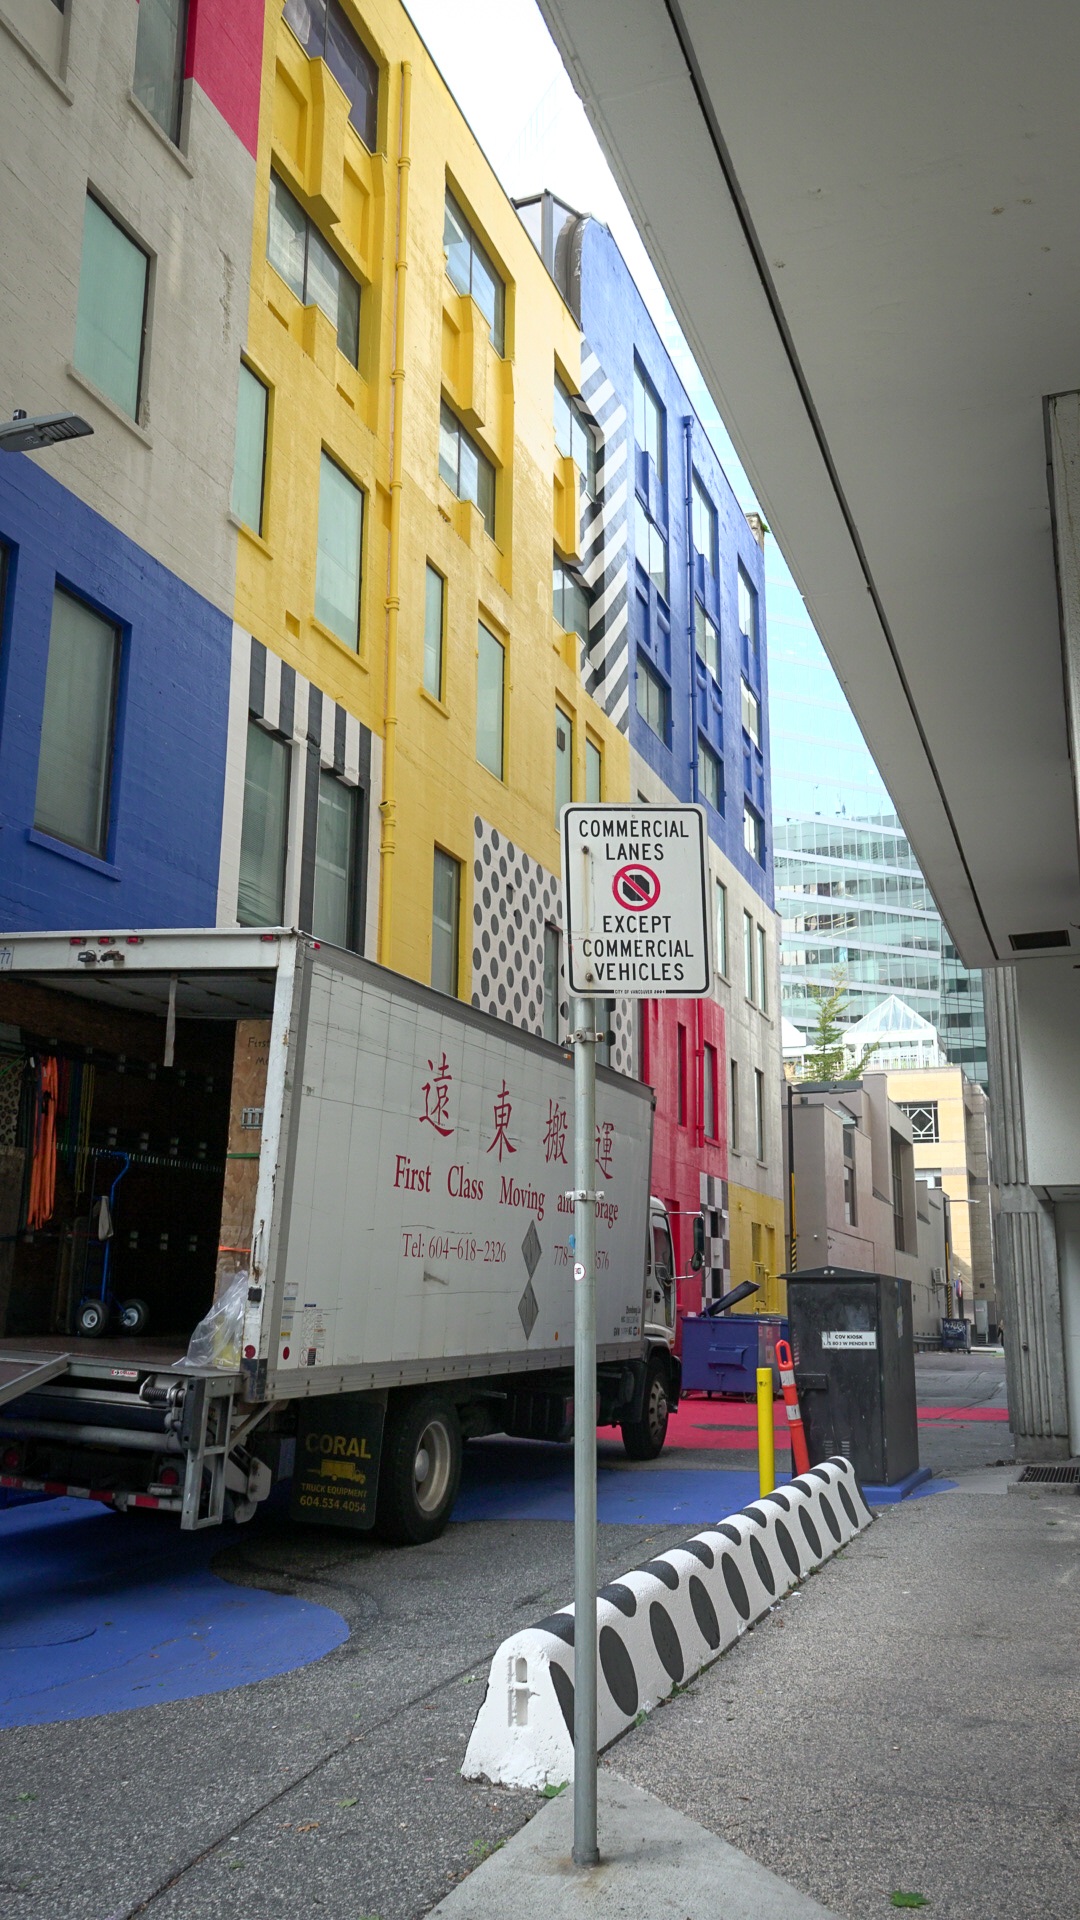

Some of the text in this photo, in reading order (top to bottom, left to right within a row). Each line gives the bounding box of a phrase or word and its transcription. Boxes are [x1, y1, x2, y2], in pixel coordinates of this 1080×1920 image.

[579, 820, 689, 838] COMMERCIAL
[606, 843, 664, 861] LANES
[603, 915, 672, 933] EXCEPT
[582, 939, 694, 958] COMMERCIAL
[594, 962, 685, 981] VEHICLES
[393, 1154, 432, 1193] First
[446, 1164, 484, 1201] Class
[499, 1175, 545, 1222] Moving
[402, 1233, 425, 1258] Tel:
[428, 1236, 507, 1263] 604-618-2326
[305, 1433, 372, 1459] CORAL
[301, 1482, 368, 1498] TRUCK EQUIPMENT
[299, 1495, 367, 1512] 604.534.4054
